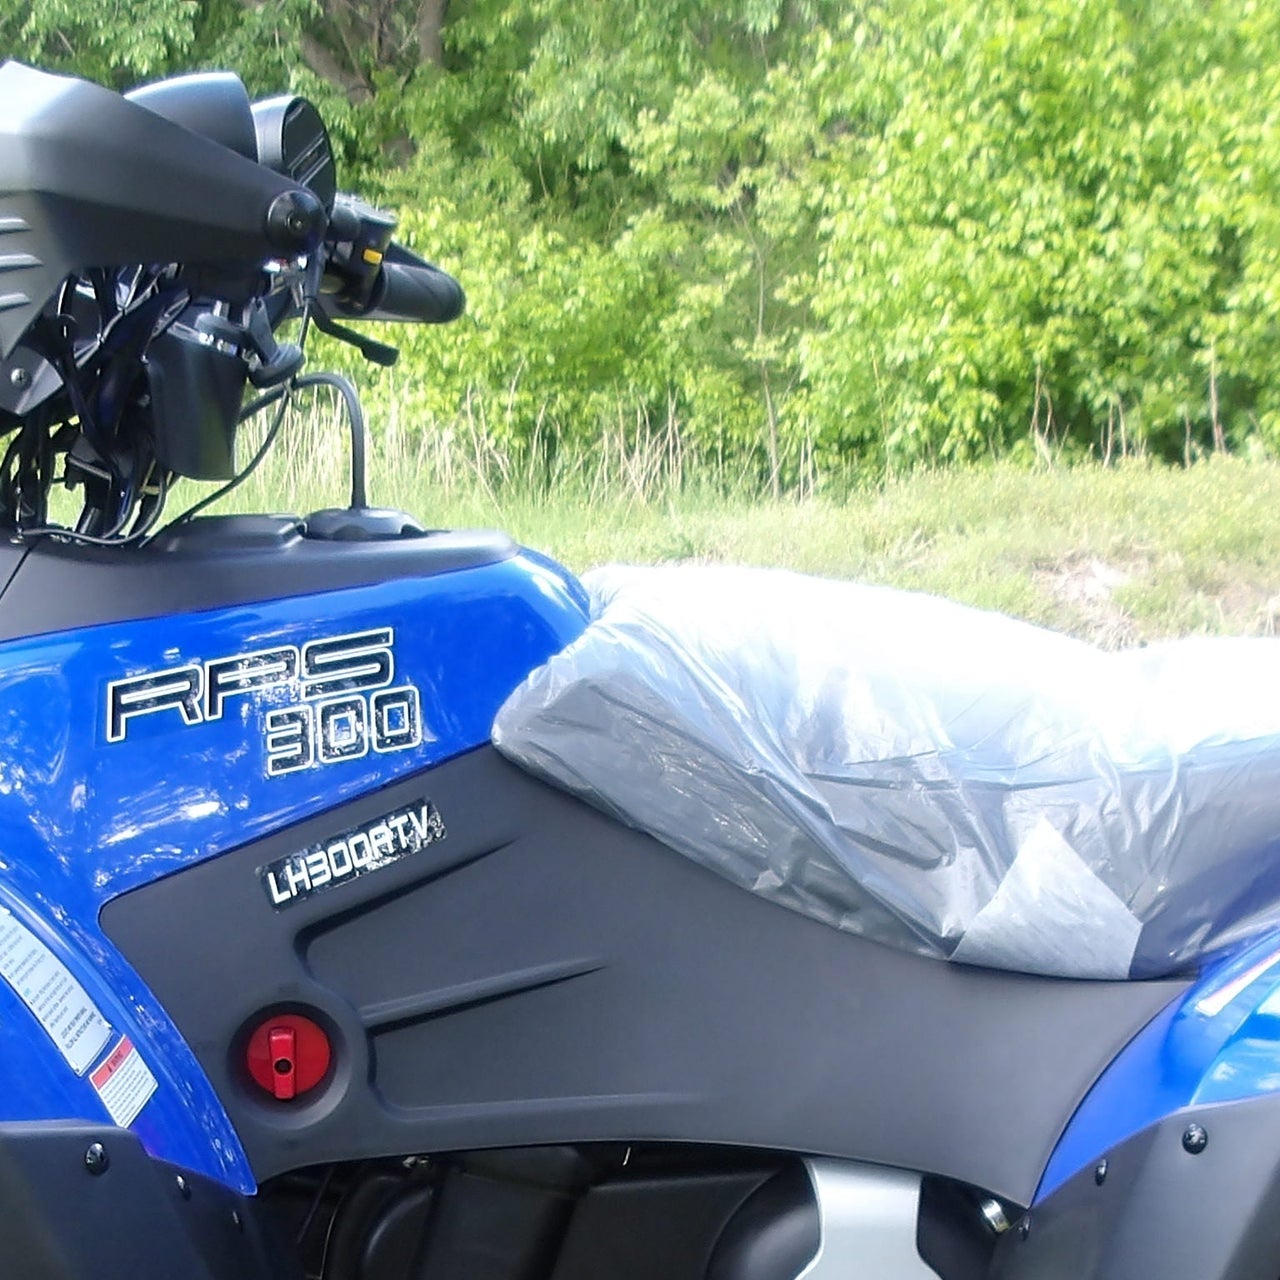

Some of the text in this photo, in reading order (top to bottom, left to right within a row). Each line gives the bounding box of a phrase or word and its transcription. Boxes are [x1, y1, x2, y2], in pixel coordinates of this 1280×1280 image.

[107, 626, 393, 743] RPS
[266, 686, 422, 776] 300
[268, 806, 430, 904] LH300ATV
